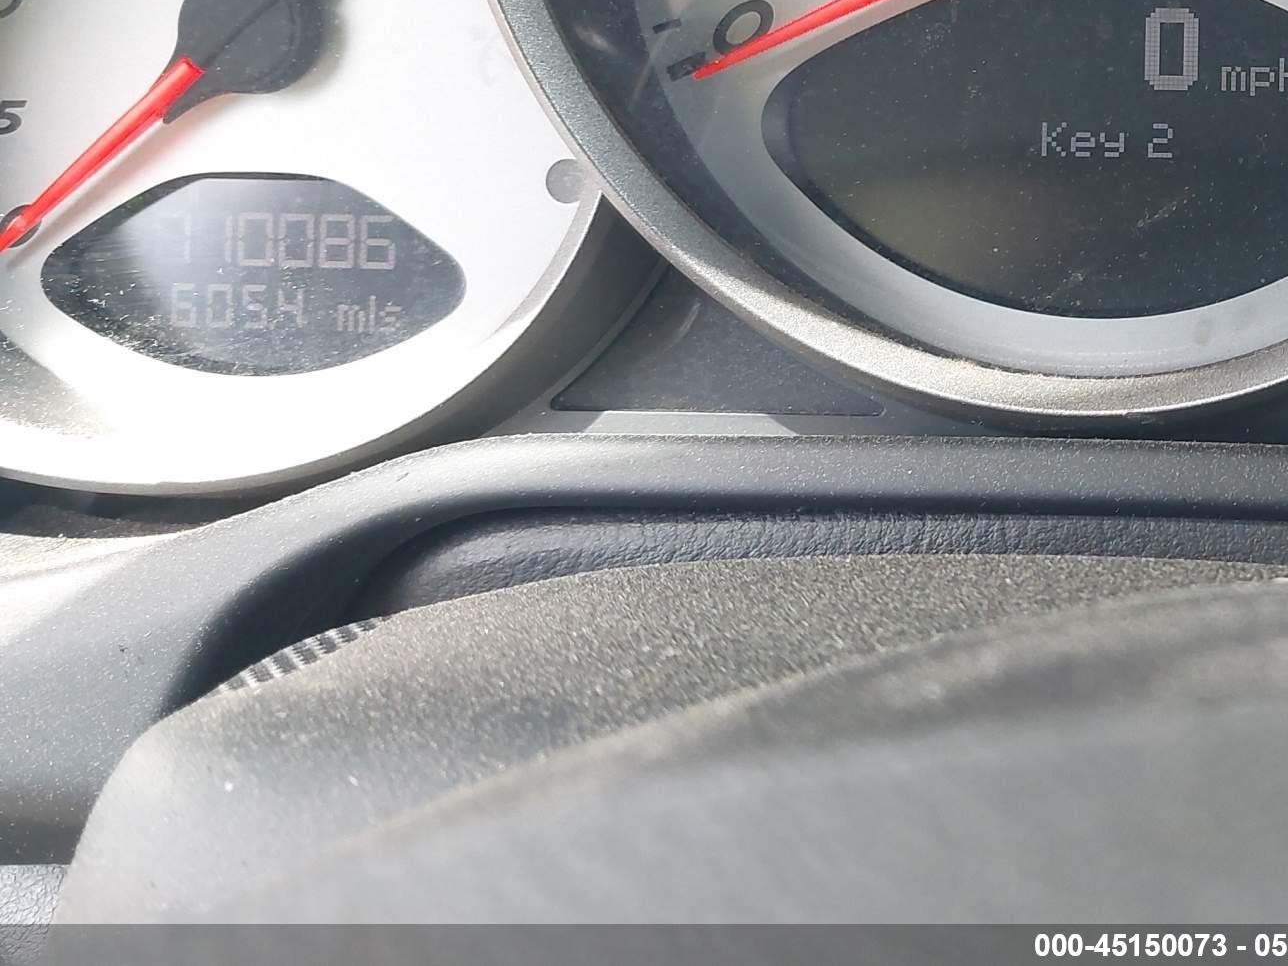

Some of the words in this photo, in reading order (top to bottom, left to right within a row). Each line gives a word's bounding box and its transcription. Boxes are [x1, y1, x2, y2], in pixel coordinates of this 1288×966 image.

[713, 0, 774, 55] 0
[1145, 7, 1199, 90] 0
[1041, 122, 1126, 157] Key
[1148, 123, 1174, 158] 2
